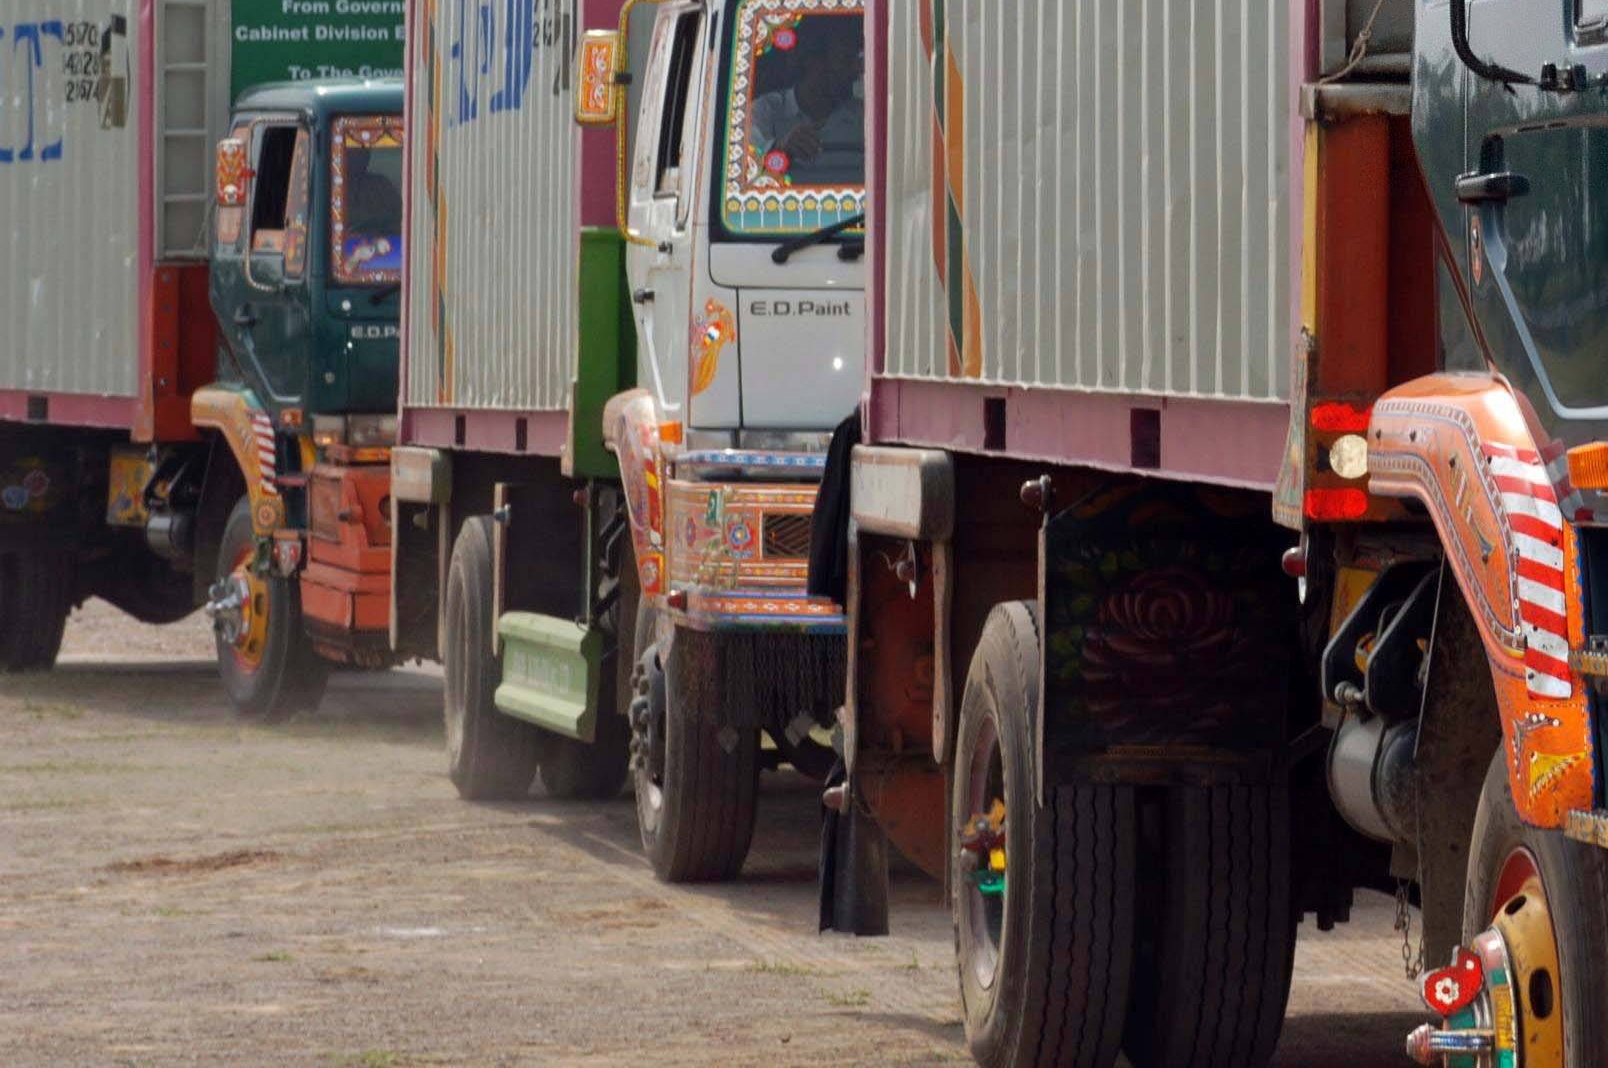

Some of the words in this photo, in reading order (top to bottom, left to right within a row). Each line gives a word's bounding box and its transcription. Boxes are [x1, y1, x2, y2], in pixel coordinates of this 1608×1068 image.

[235, 24, 309, 41] Cabinet
[315, 24, 388, 40] Division
[288, 65, 311, 80] To
[317, 65, 352, 78] The
[750, 301, 850, 317] E.D.Paint
